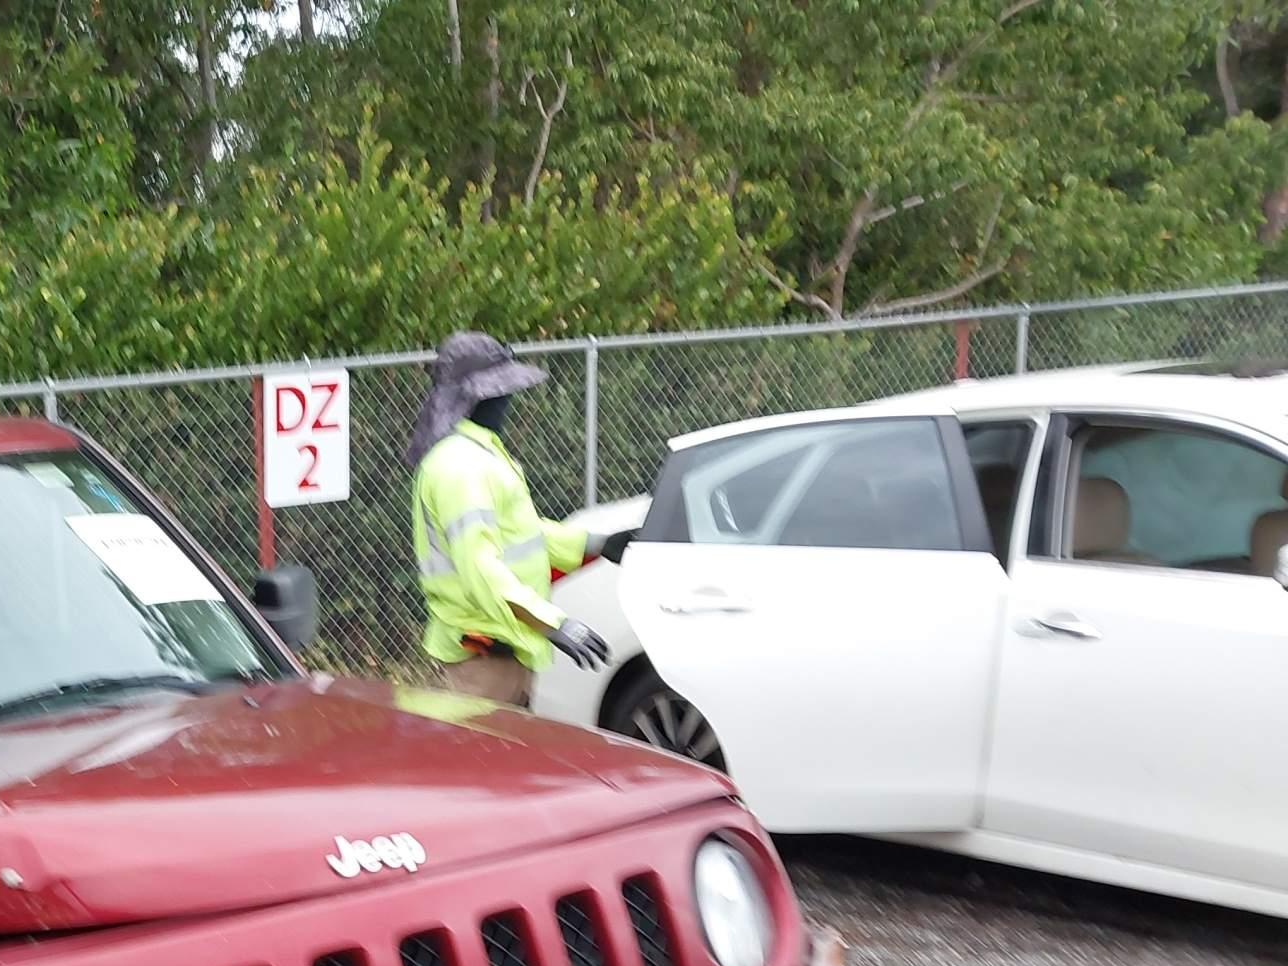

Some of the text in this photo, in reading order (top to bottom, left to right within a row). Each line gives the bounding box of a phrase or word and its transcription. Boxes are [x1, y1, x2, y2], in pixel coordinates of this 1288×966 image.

[276, 383, 339, 432] DZ
[298, 445, 320, 488] 2
[325, 832, 427, 878] Jeep
